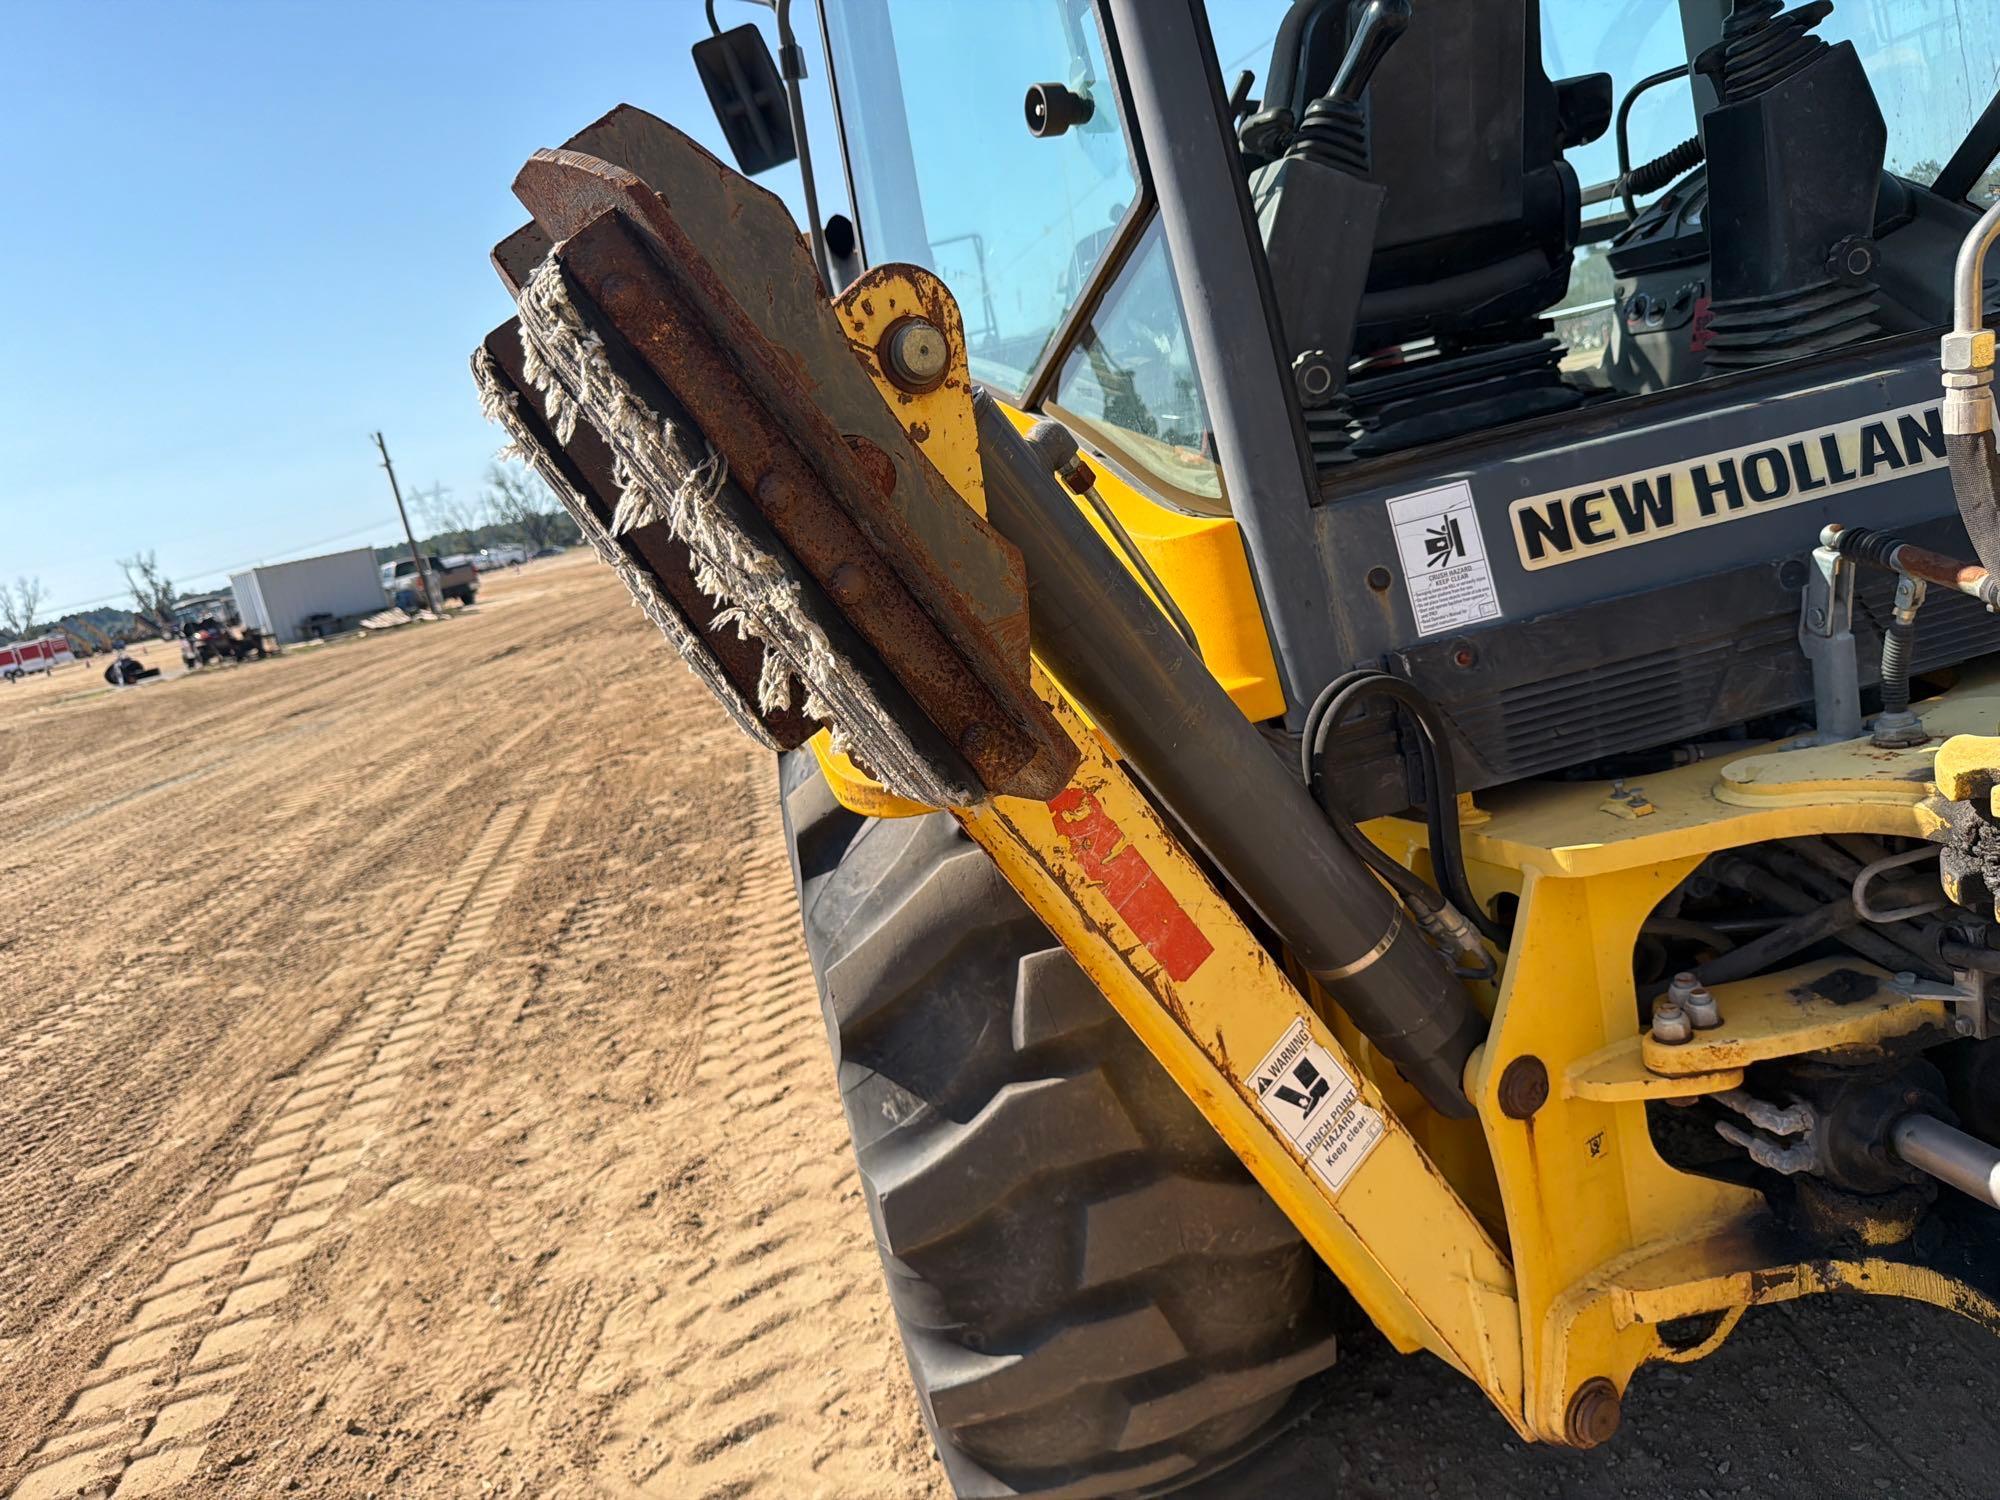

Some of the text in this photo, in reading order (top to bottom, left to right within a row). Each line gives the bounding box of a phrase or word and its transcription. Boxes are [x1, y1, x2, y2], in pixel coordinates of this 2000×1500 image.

[1517, 406, 1949, 560] NEW HOLLAN
[1428, 565, 1473, 582] CRUSH HAZARD
[1435, 578, 1450, 586] KEEP
[1451, 573, 1469, 582] CLEAR
[1268, 1029, 1310, 1077] WARNING
[1306, 1089, 1359, 1152] PINCH POINT
[1322, 1110, 1356, 1152] HAZARD
[1325, 1141, 1349, 1167] Keep
[1346, 1116, 1369, 1142] clear.
